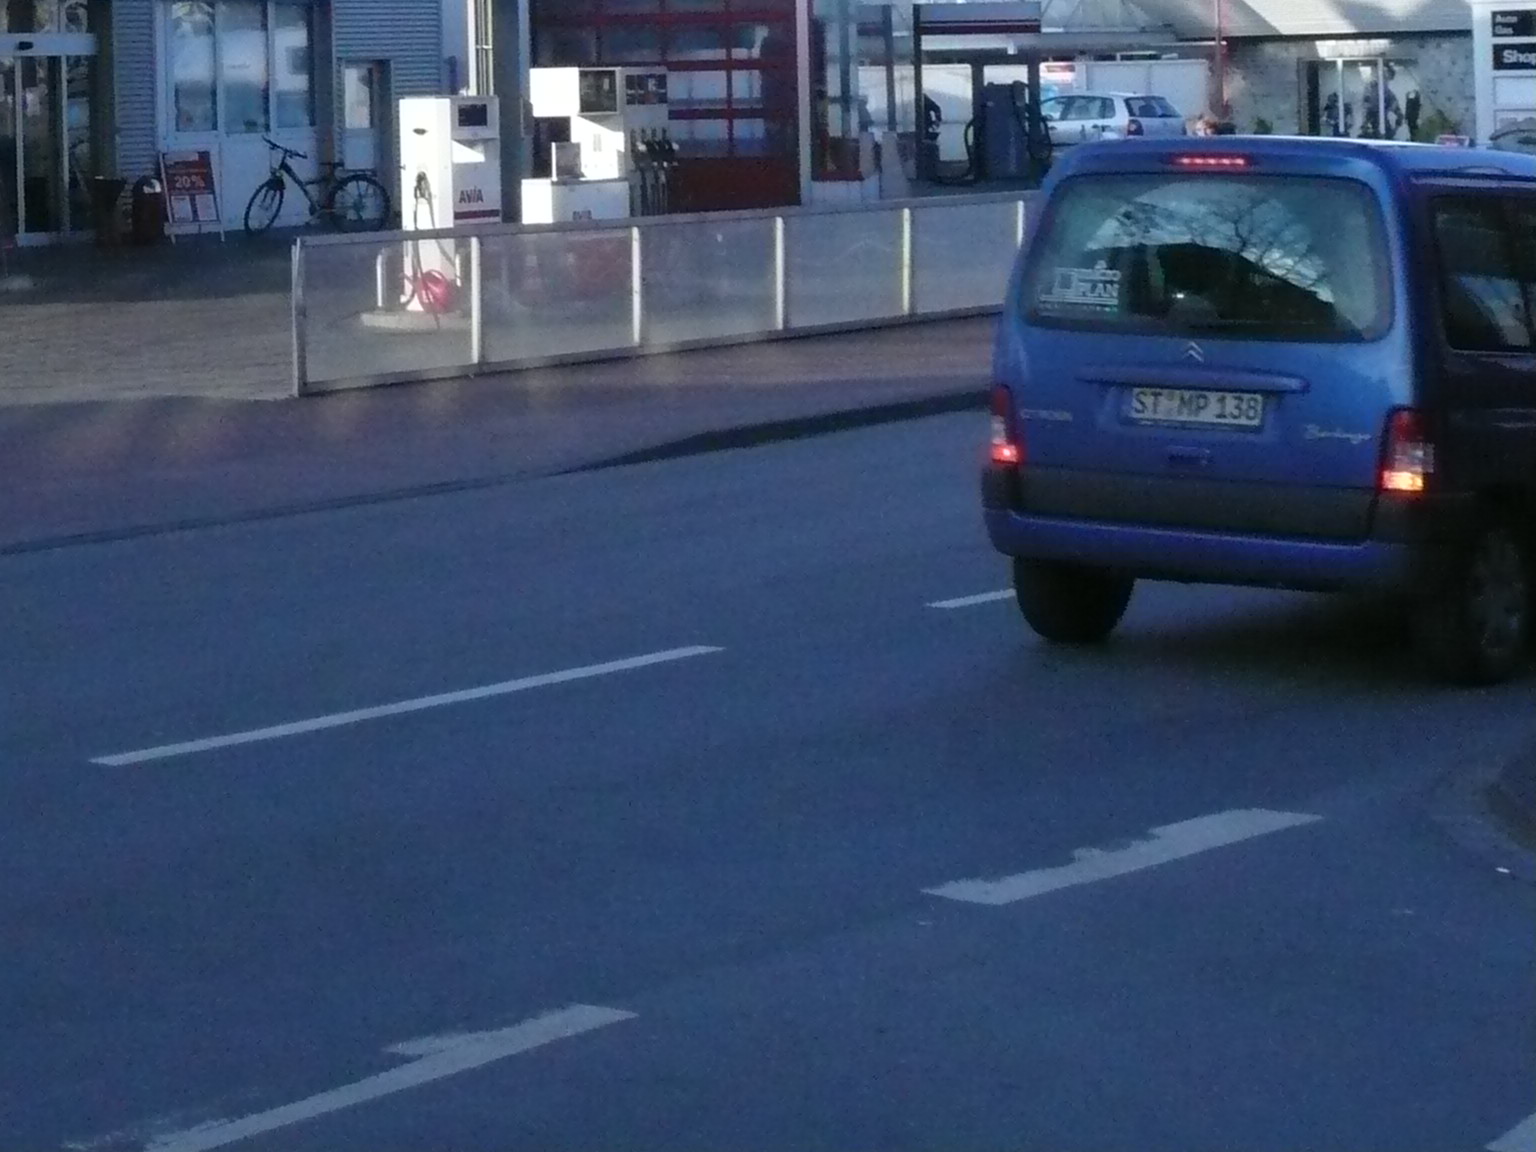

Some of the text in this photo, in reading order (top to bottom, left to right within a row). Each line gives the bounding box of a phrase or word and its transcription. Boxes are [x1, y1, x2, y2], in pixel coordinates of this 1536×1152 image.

[174, 174, 206, 188] 20%
[458, 185, 484, 204] AVIA
[1133, 390, 1260, 421] ST MP 138
